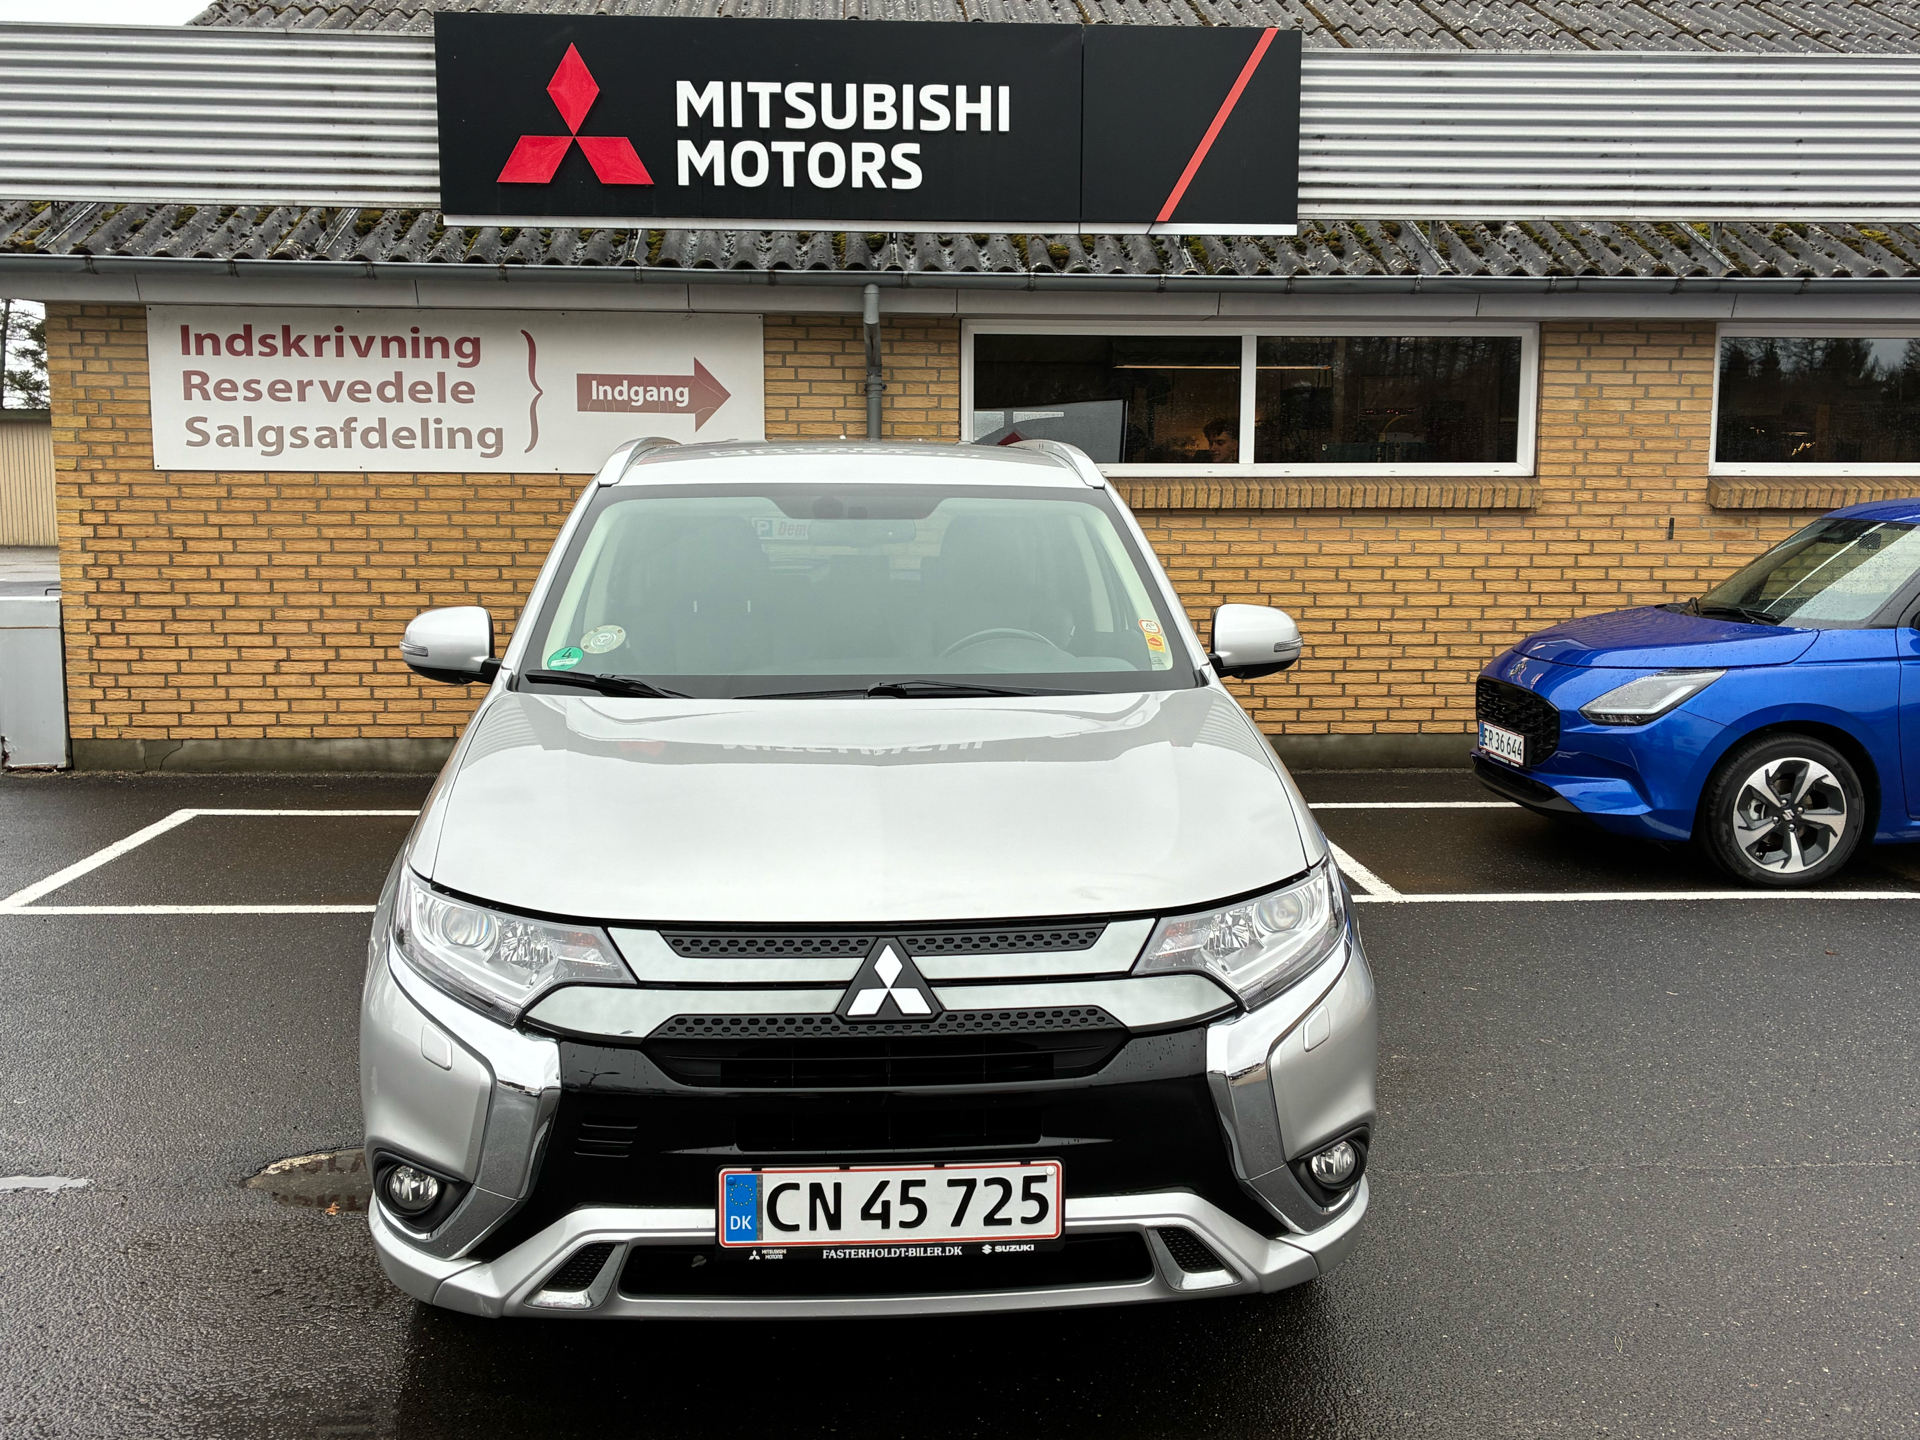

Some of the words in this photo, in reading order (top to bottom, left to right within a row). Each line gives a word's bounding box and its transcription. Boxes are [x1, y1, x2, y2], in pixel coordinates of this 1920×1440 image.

[675, 80, 1010, 132] MITSUBISHI
[676, 140, 923, 190] MOTORS
[180, 324, 482, 367] Indskrivning
[182, 370, 476, 404] Reservedele
[590, 380, 690, 407] Indgang
[185, 415, 503, 459] Salgsafdeling
[1484, 728, 1494, 748] ER
[1495, 732, 1505, 752] 36
[1506, 736, 1522, 760] 644
[766, 1182, 842, 1232] CN
[860, 1179, 929, 1230] 45
[947, 1175, 1049, 1228] 725
[730, 1215, 752, 1230] DK
[822, 1246, 963, 1260] FASTERHOLDT-BILER.DK
[994, 1243, 1035, 1253] SUZUKI
